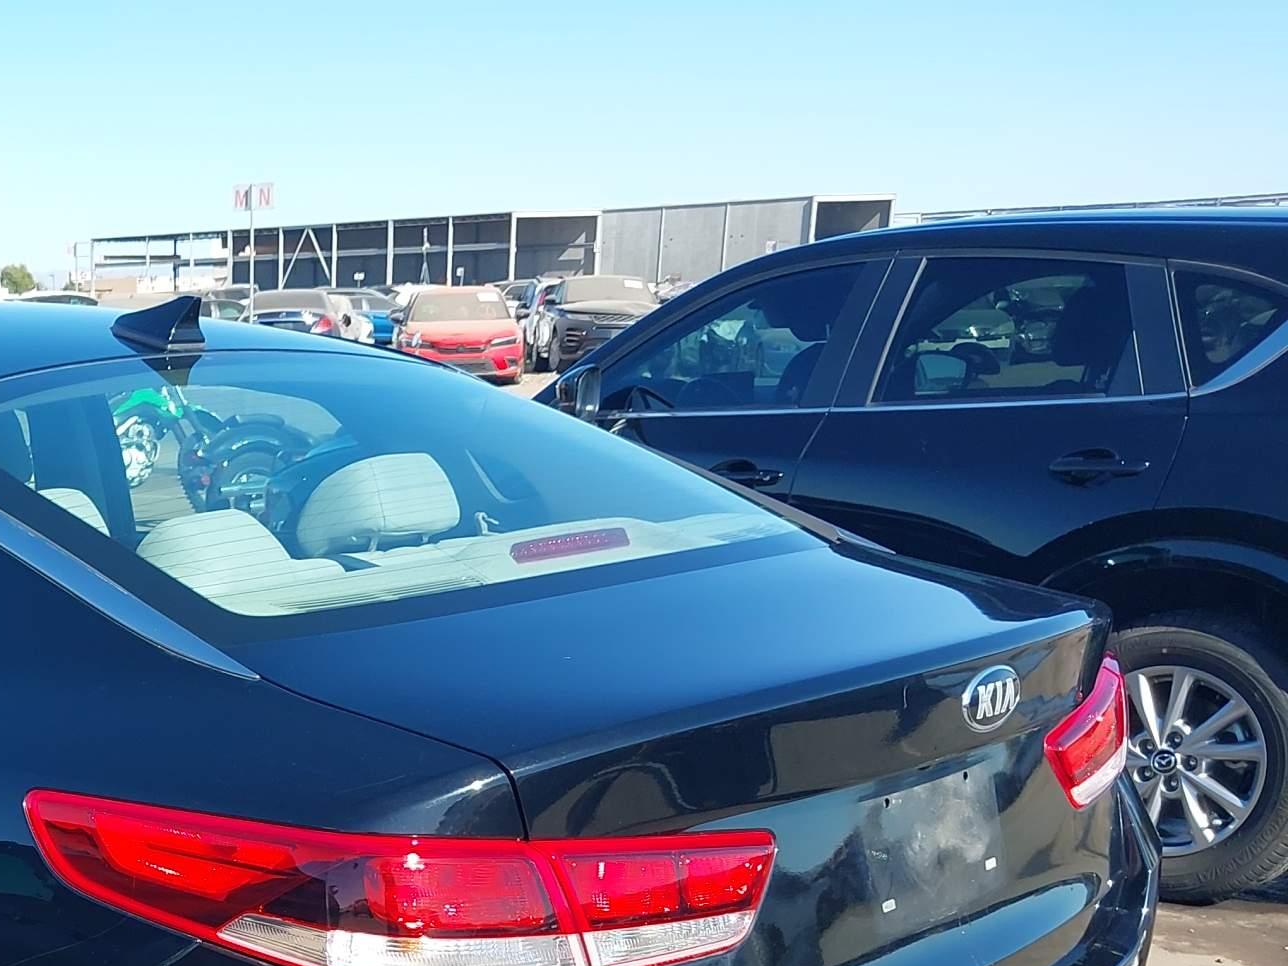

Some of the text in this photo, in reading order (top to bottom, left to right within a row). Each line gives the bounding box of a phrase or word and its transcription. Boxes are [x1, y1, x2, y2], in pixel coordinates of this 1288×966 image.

[234, 189, 249, 209] M
[258, 187, 271, 208] N
[975, 677, 1016, 720] KIA
